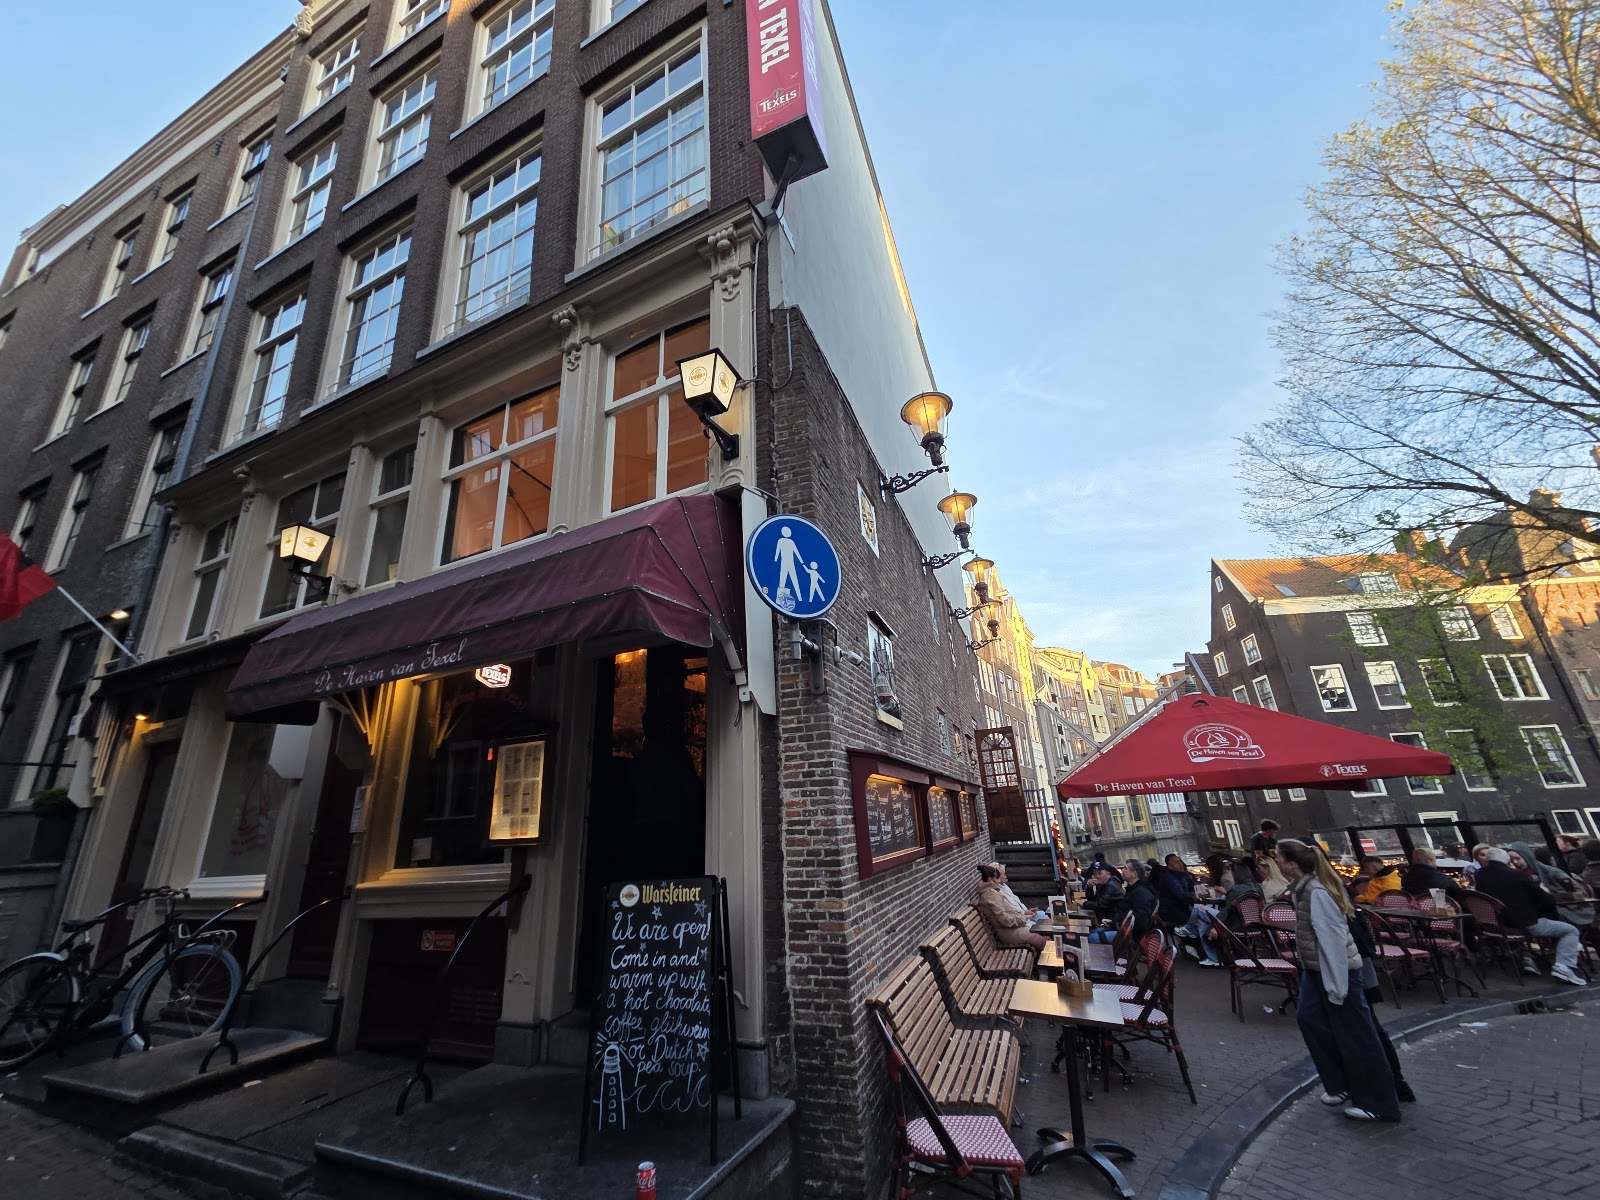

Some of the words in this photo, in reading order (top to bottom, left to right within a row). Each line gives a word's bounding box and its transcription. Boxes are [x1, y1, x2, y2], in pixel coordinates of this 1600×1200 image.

[759, 7, 790, 74] TEXEL
[314, 670, 332, 693] De
[338, 662, 384, 688] Haven
[390, 663, 415, 676] van
[421, 637, 468, 669] Texel
[1239, 749, 1259, 757] Texel
[1094, 783, 1109, 792] De
[1110, 782, 1144, 791] Haven
[1146, 781, 1165, 789] van
[1166, 776, 1196, 787] Texel
[642, 882, 701, 905] Warsteiner
[612, 911, 636, 940] We
[639, 923, 669, 940] are
[672, 912, 711, 948] open!
[610, 944, 649, 969] Come
[652, 950, 666, 967] in
[669, 946, 700, 967] and
[609, 972, 654, 989] warm
[657, 971, 678, 997] up
[680, 969, 707, 991] with
[607, 992, 617, 1009] a
[623, 988, 653, 1010] hot
[647, 1010, 711, 1046] glühwein
[628, 1043, 646, 1060] or
[651, 1034, 695, 1063] Dutch
[634, 1061, 664, 1087] pea
[668, 1060, 701, 1094] soup.
